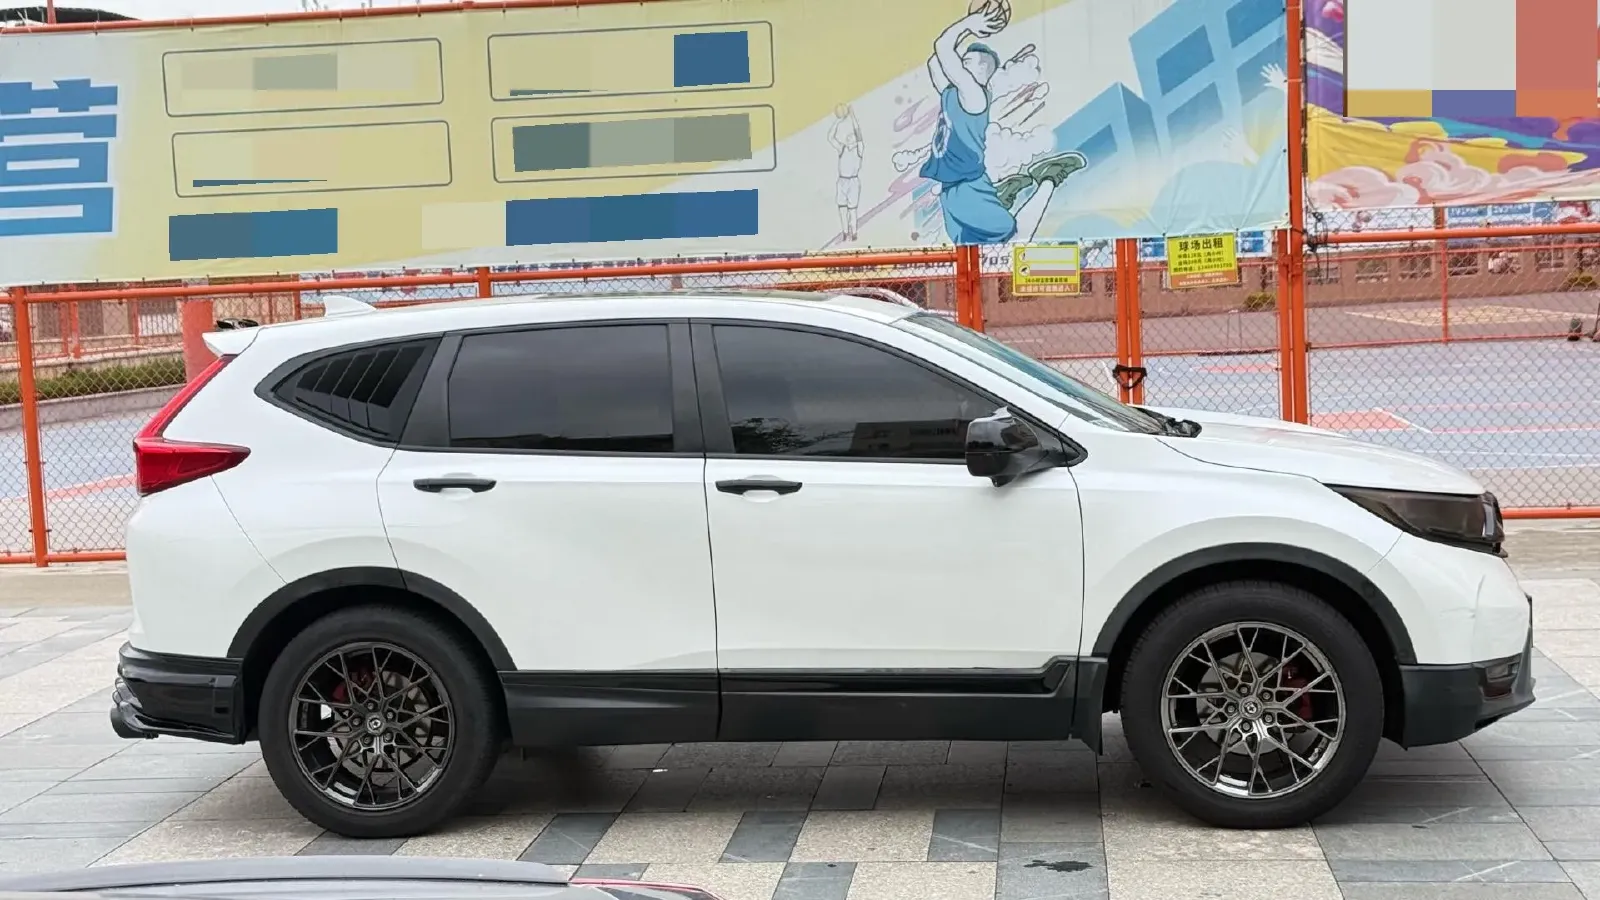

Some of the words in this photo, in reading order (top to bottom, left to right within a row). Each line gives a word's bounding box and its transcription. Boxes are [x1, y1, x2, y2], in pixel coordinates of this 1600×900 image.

[0, 78, 118, 237] 营
[1179, 238, 1223, 251] 球场出租
